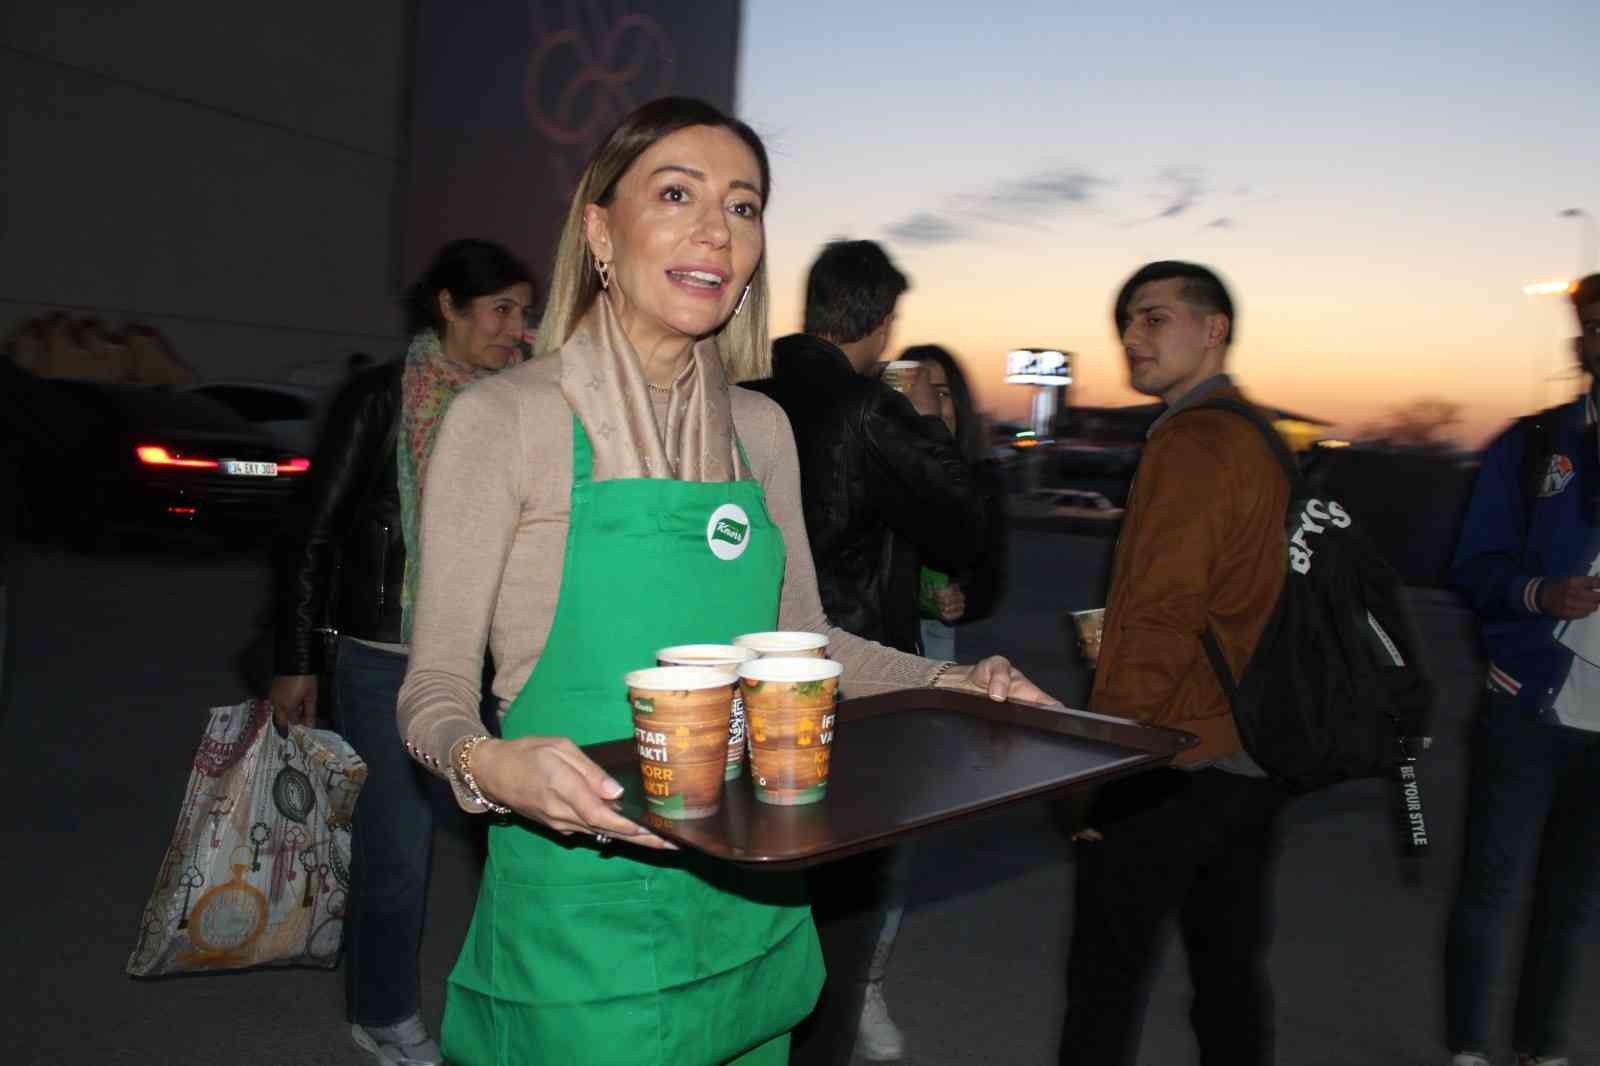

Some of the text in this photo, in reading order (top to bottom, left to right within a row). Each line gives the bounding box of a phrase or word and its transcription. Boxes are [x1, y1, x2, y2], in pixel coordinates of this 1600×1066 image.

[1400, 765, 1428, 846] BE YOUR STYLE
